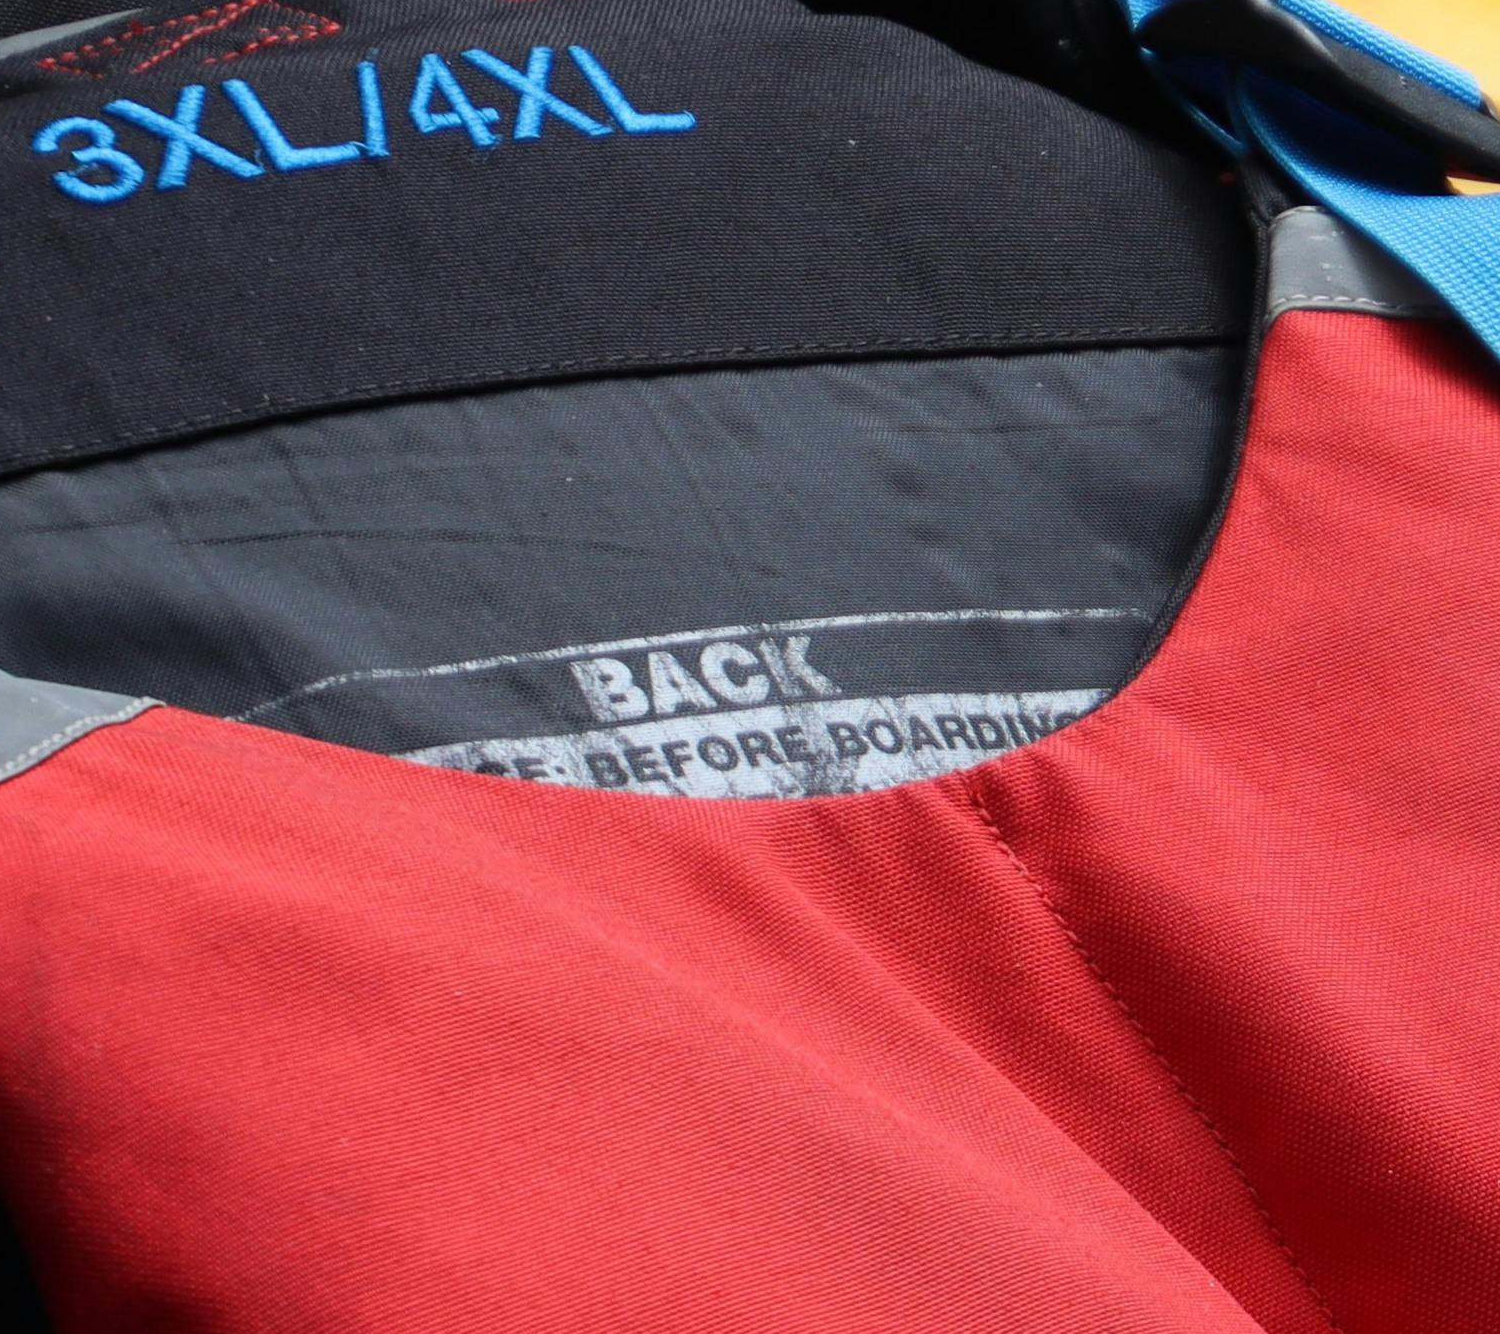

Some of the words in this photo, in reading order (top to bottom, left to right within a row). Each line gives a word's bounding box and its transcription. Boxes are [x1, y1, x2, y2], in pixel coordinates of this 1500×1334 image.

[32, 44, 697, 204] 3XL/4XL
[569, 634, 842, 723] BACK
[584, 724, 816, 789] BEFORE
